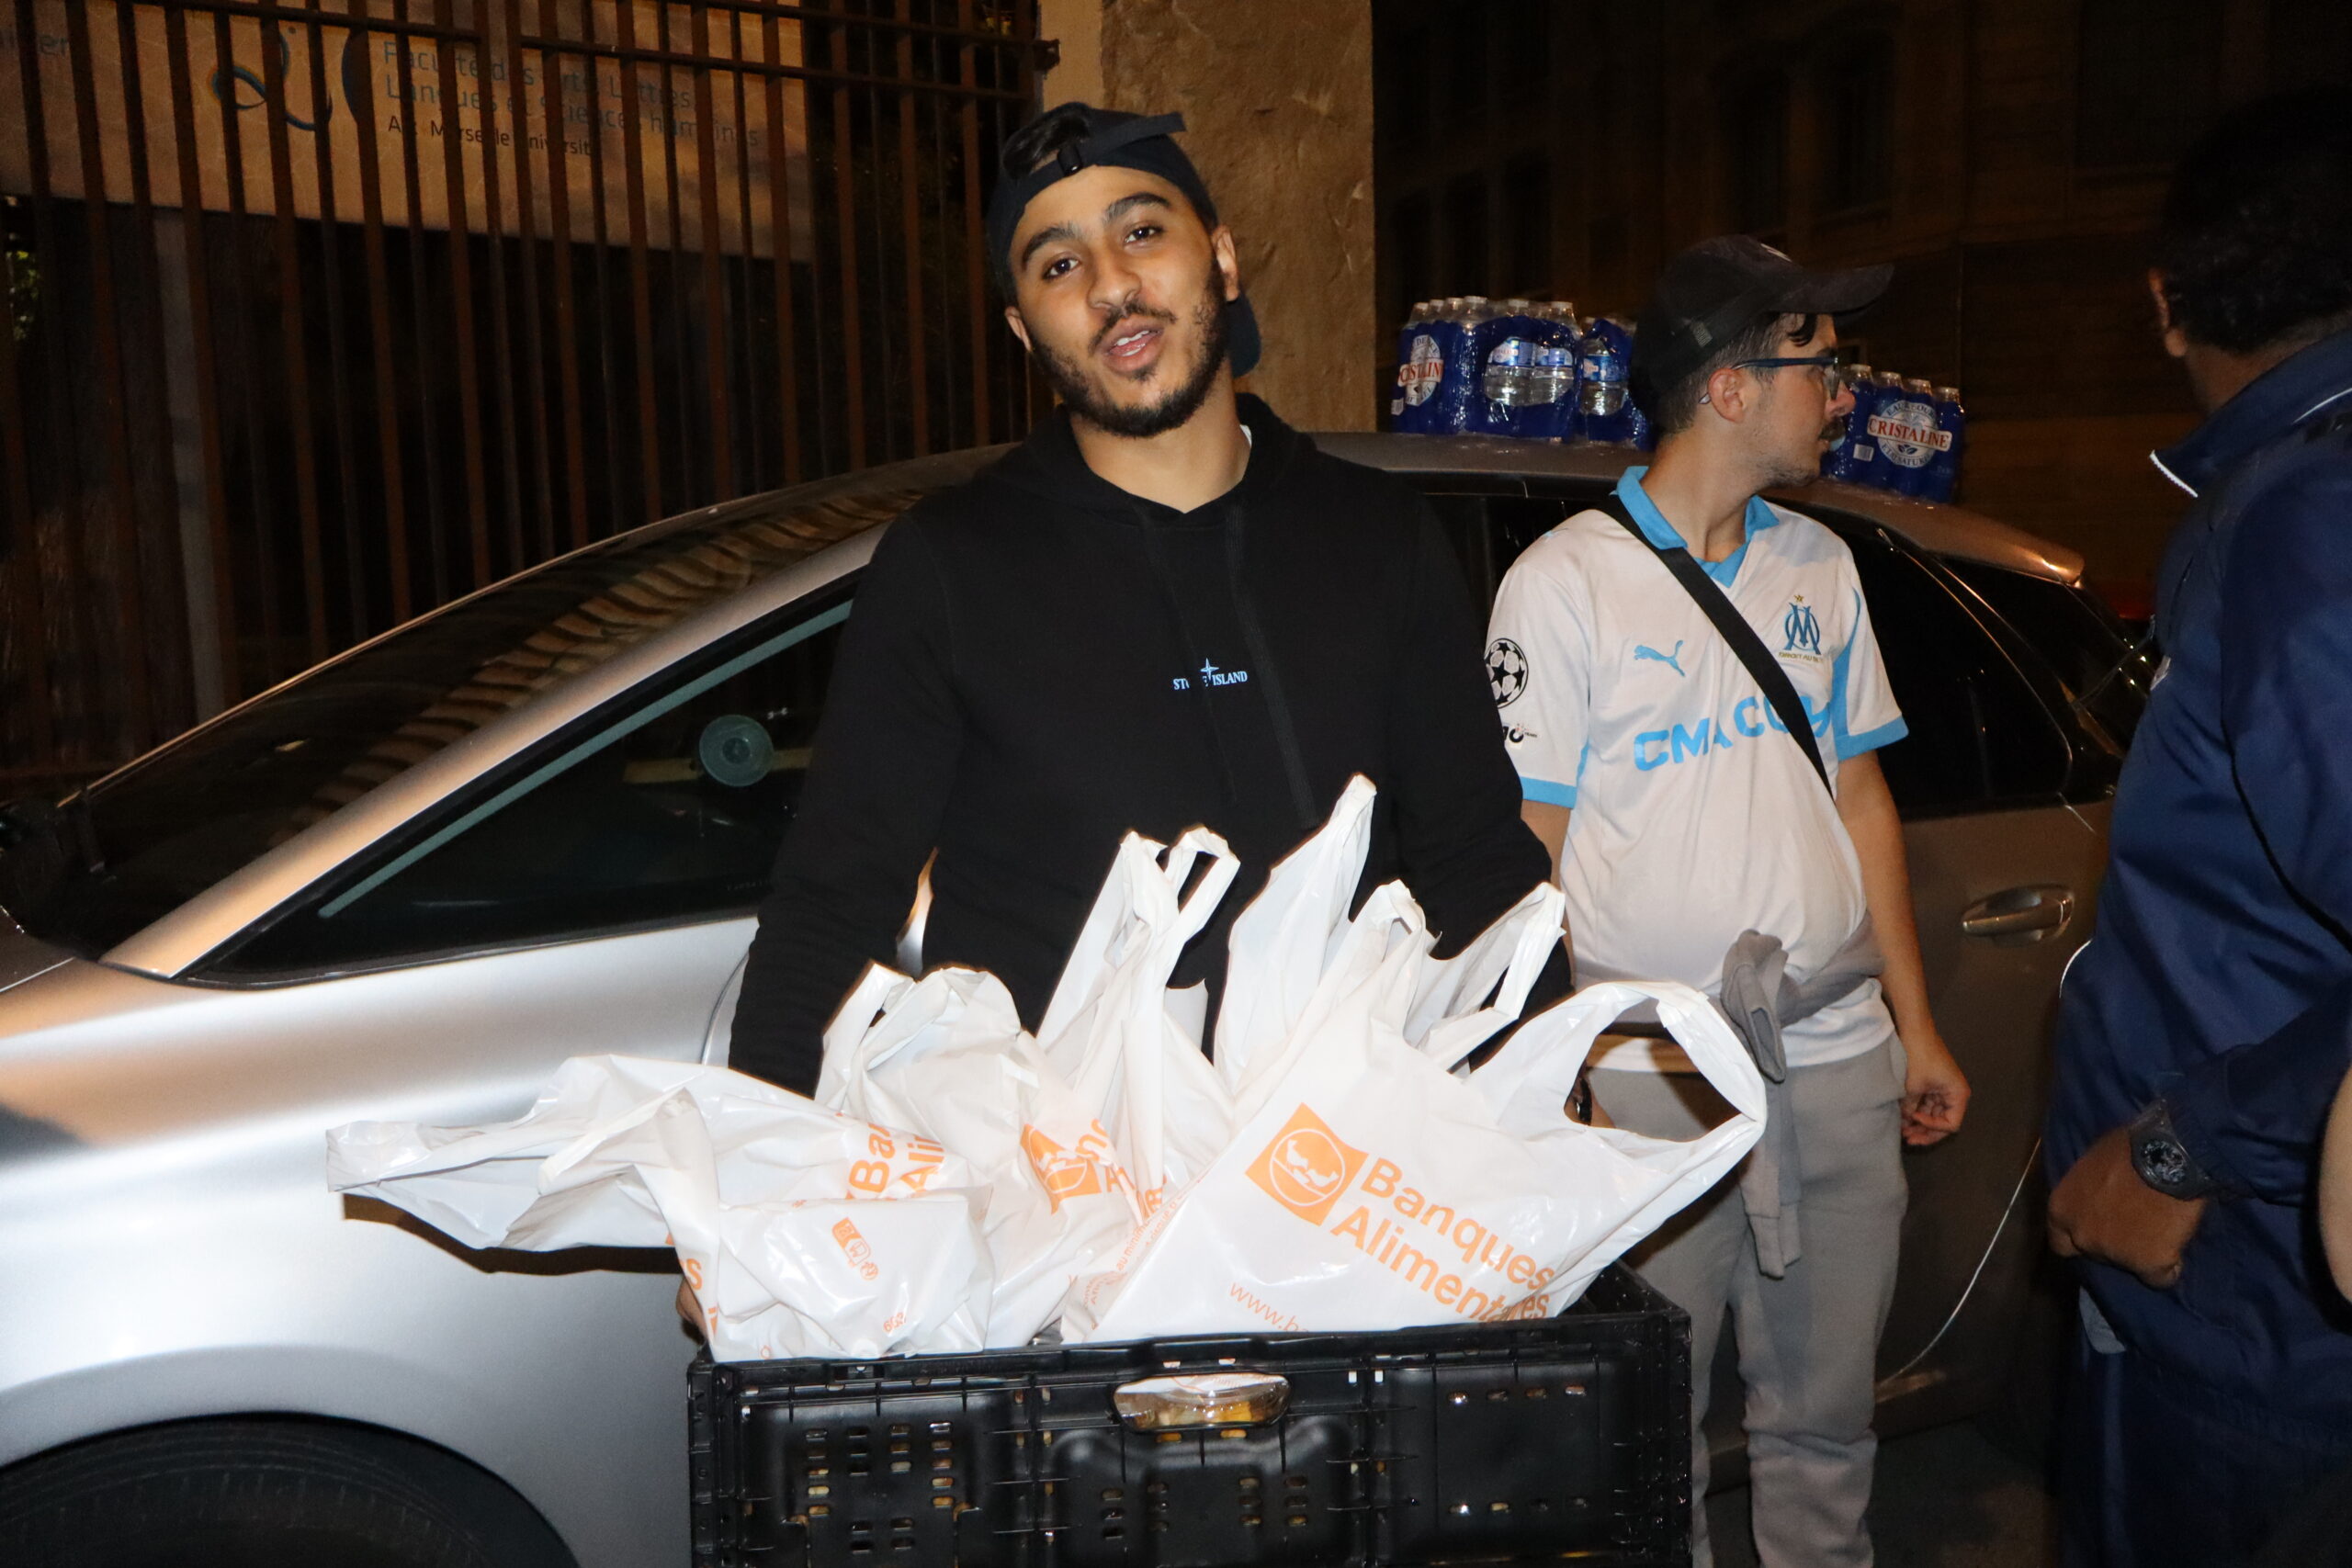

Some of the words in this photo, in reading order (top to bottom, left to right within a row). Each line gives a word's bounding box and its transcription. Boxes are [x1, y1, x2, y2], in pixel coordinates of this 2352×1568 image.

[1869, 417, 1949, 448] CRISTALINE
[1212, 671, 1249, 686] ISLAND
[1360, 1156, 1555, 1292] Banques
